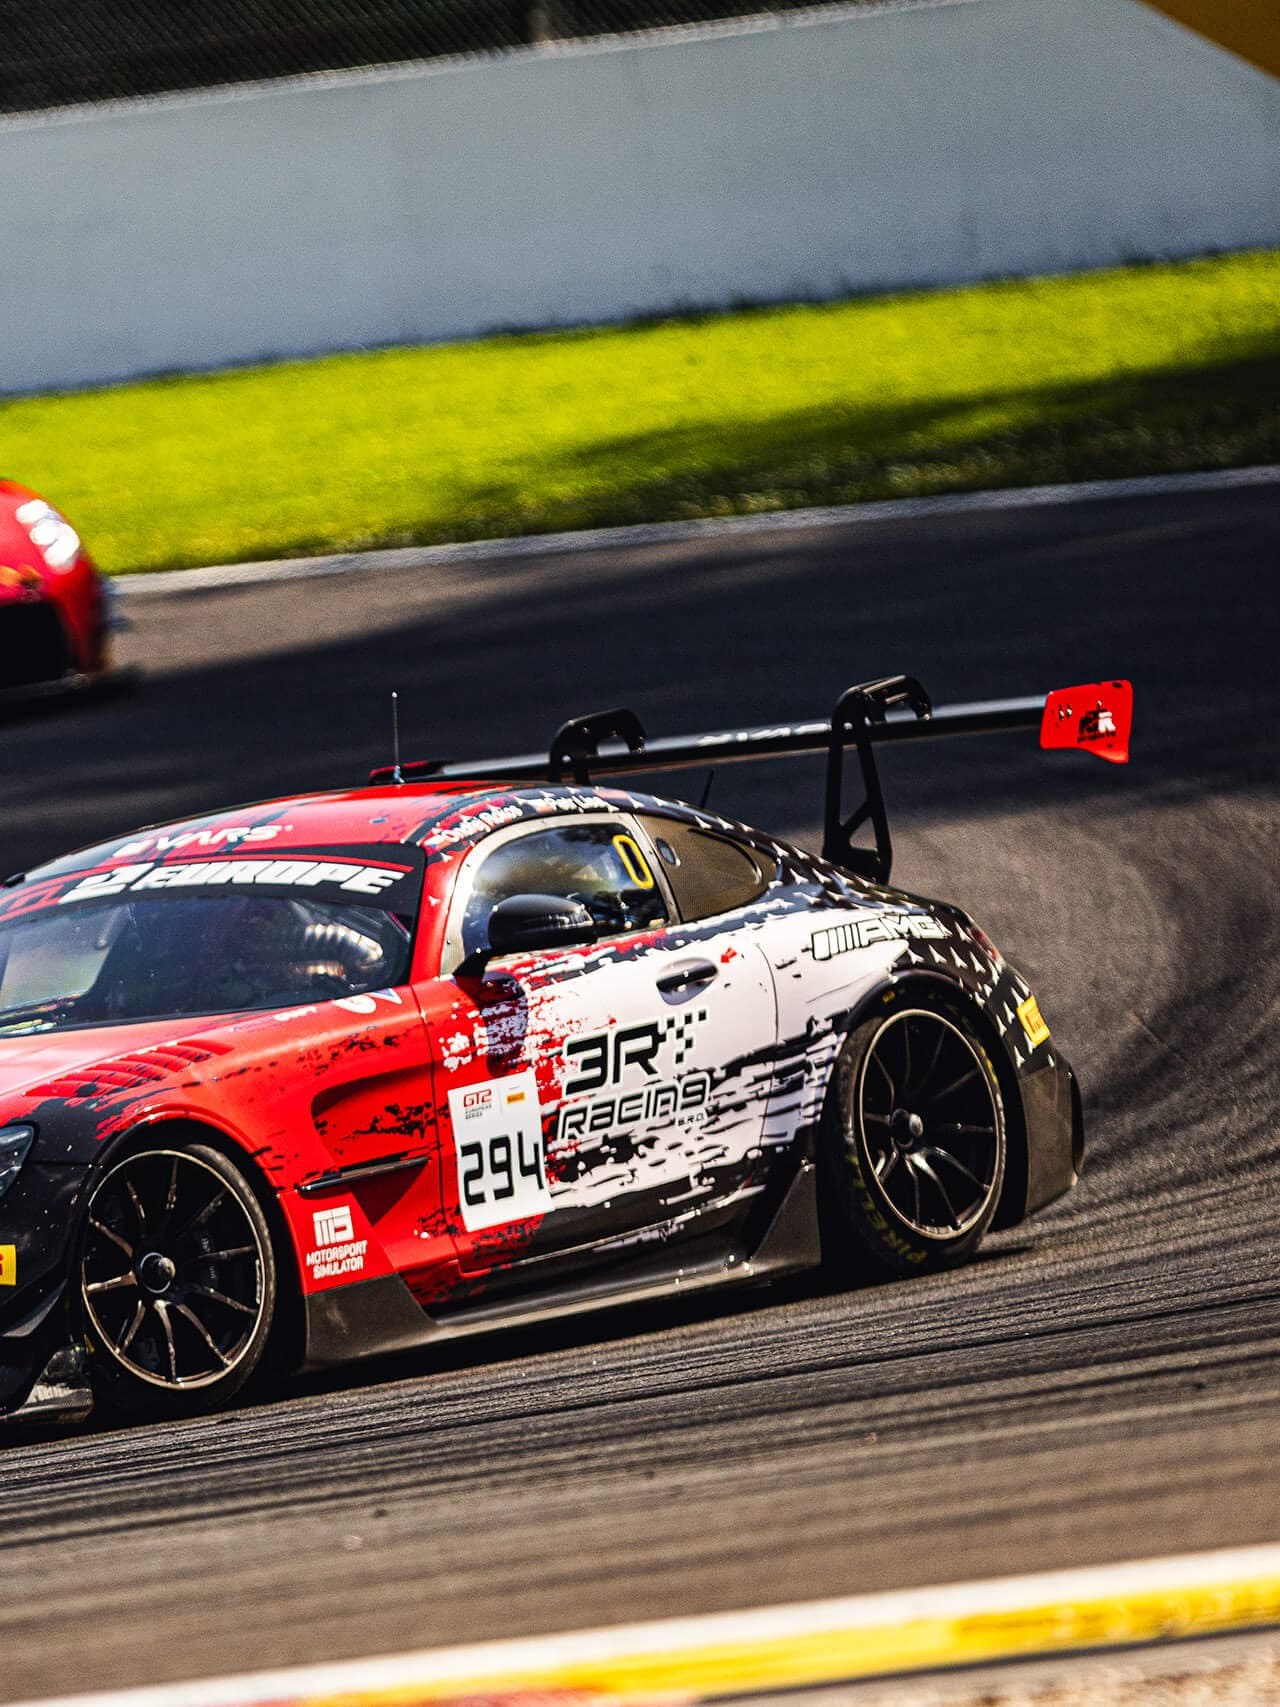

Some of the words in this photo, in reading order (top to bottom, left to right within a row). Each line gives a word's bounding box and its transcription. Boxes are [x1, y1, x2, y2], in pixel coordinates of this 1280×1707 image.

[130, 859, 405, 896] EUROPE
[565, 1021, 666, 1097] 3R
[463, 1088, 493, 1108] GT2
[460, 1130, 545, 1206] 294
[306, 1239, 368, 1267] MOTORSPORT
[313, 1255, 365, 1280] SIMULATOR
